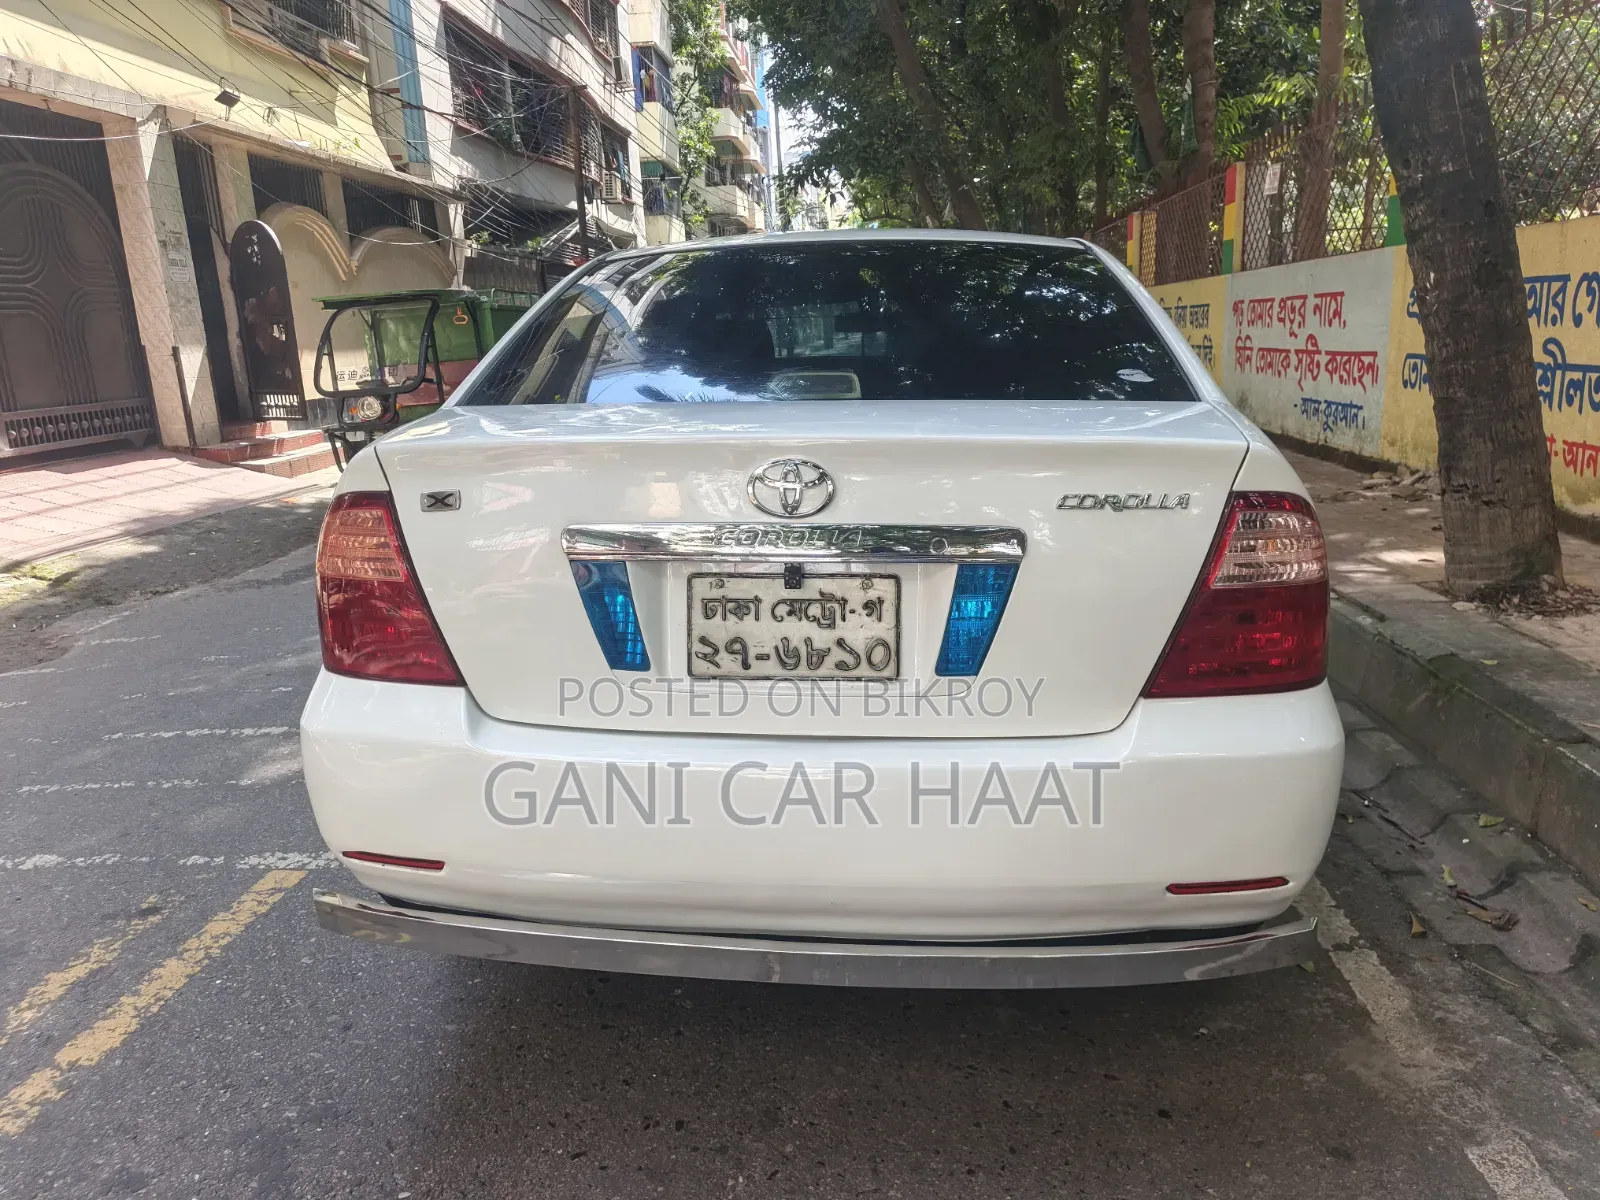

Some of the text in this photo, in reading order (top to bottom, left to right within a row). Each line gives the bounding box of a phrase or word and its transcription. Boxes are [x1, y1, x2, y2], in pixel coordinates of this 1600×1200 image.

[1247, 297, 1275, 328] তোমার
[1313, 291, 1346, 329] নামে,
[1234, 334, 1254, 374] যিনি
[1256, 347, 1291, 380] তোমাকে
[1294, 333, 1322, 392] সৃষ্টি
[1056, 493, 1191, 512] COROLLA
[713, 526, 863, 549] COROLLA
[701, 595, 762, 621] ঢাকা
[695, 636, 891, 671] ২৭-৬৮১০
